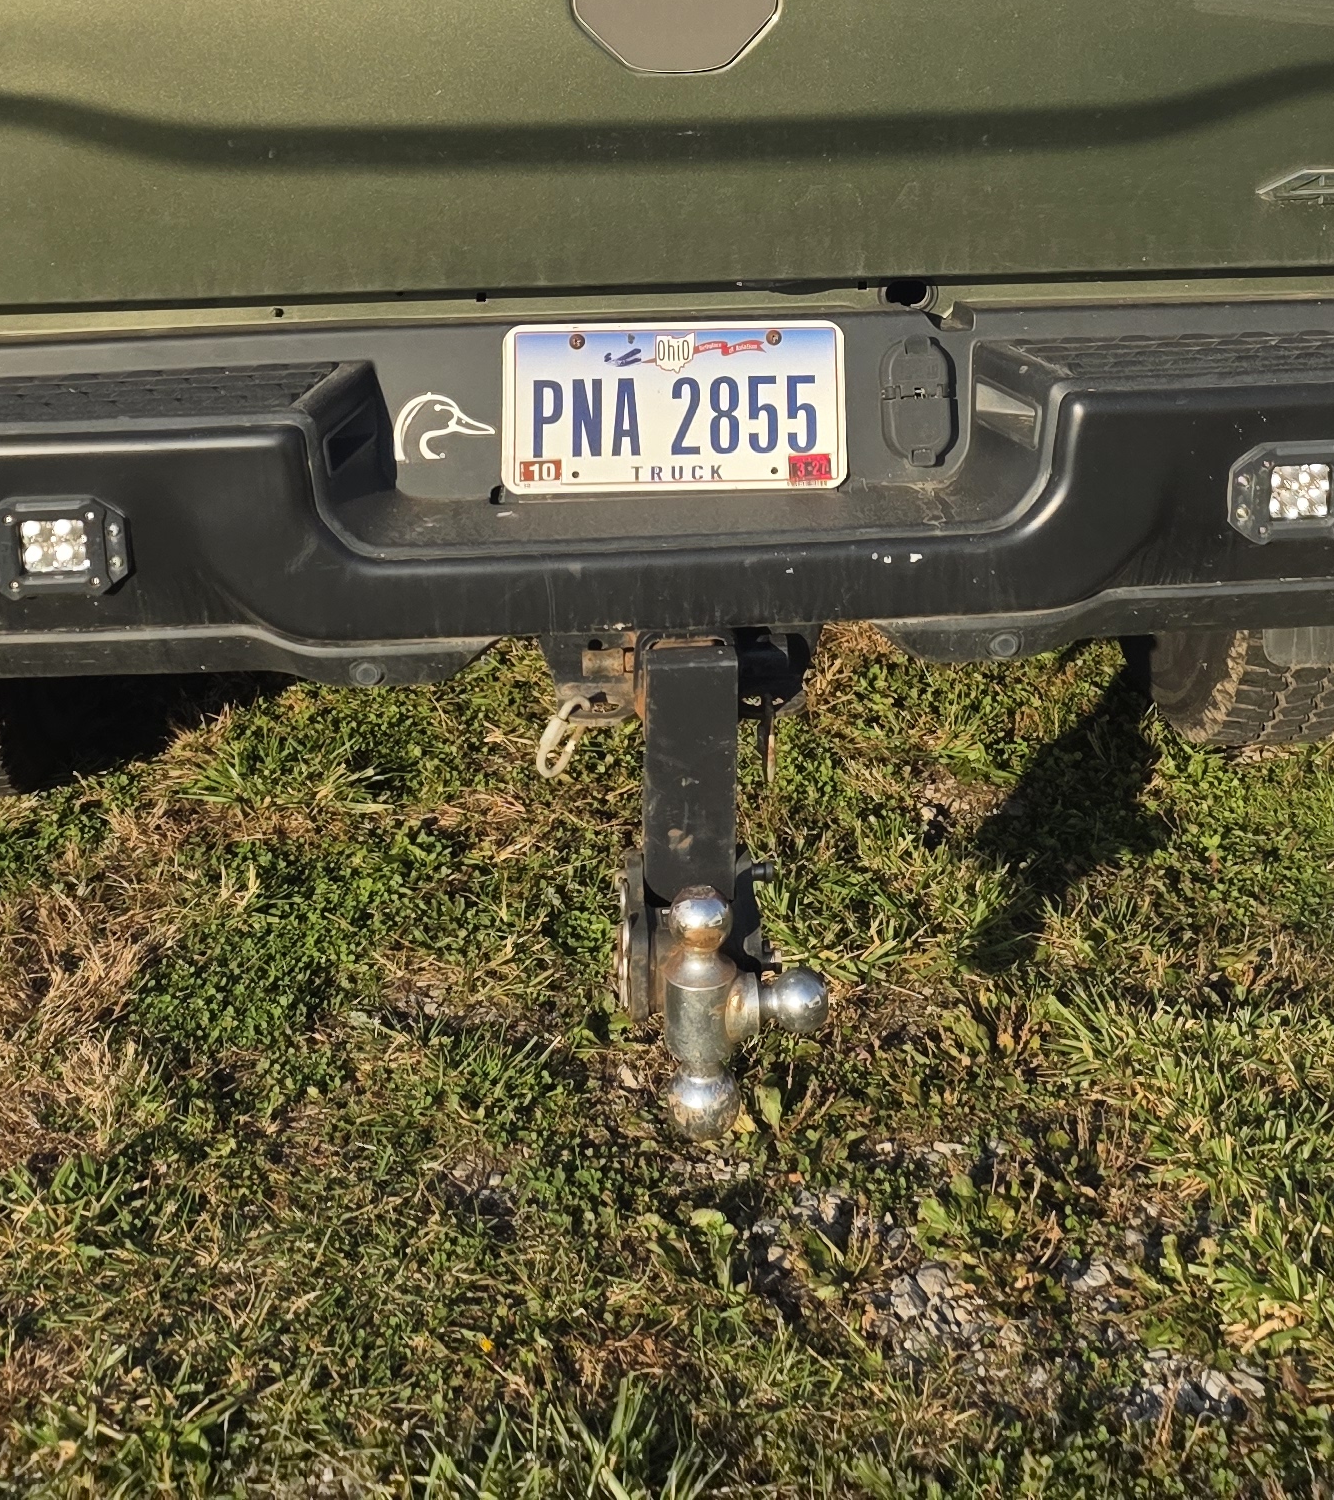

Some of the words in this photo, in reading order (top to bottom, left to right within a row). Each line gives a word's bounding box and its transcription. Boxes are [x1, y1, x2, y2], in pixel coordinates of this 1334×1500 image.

[532, 377, 642, 459] PNA
[670, 375, 818, 455] 2855
[529, 463, 556, 481] 10
[632, 463, 724, 482] TRUCK
